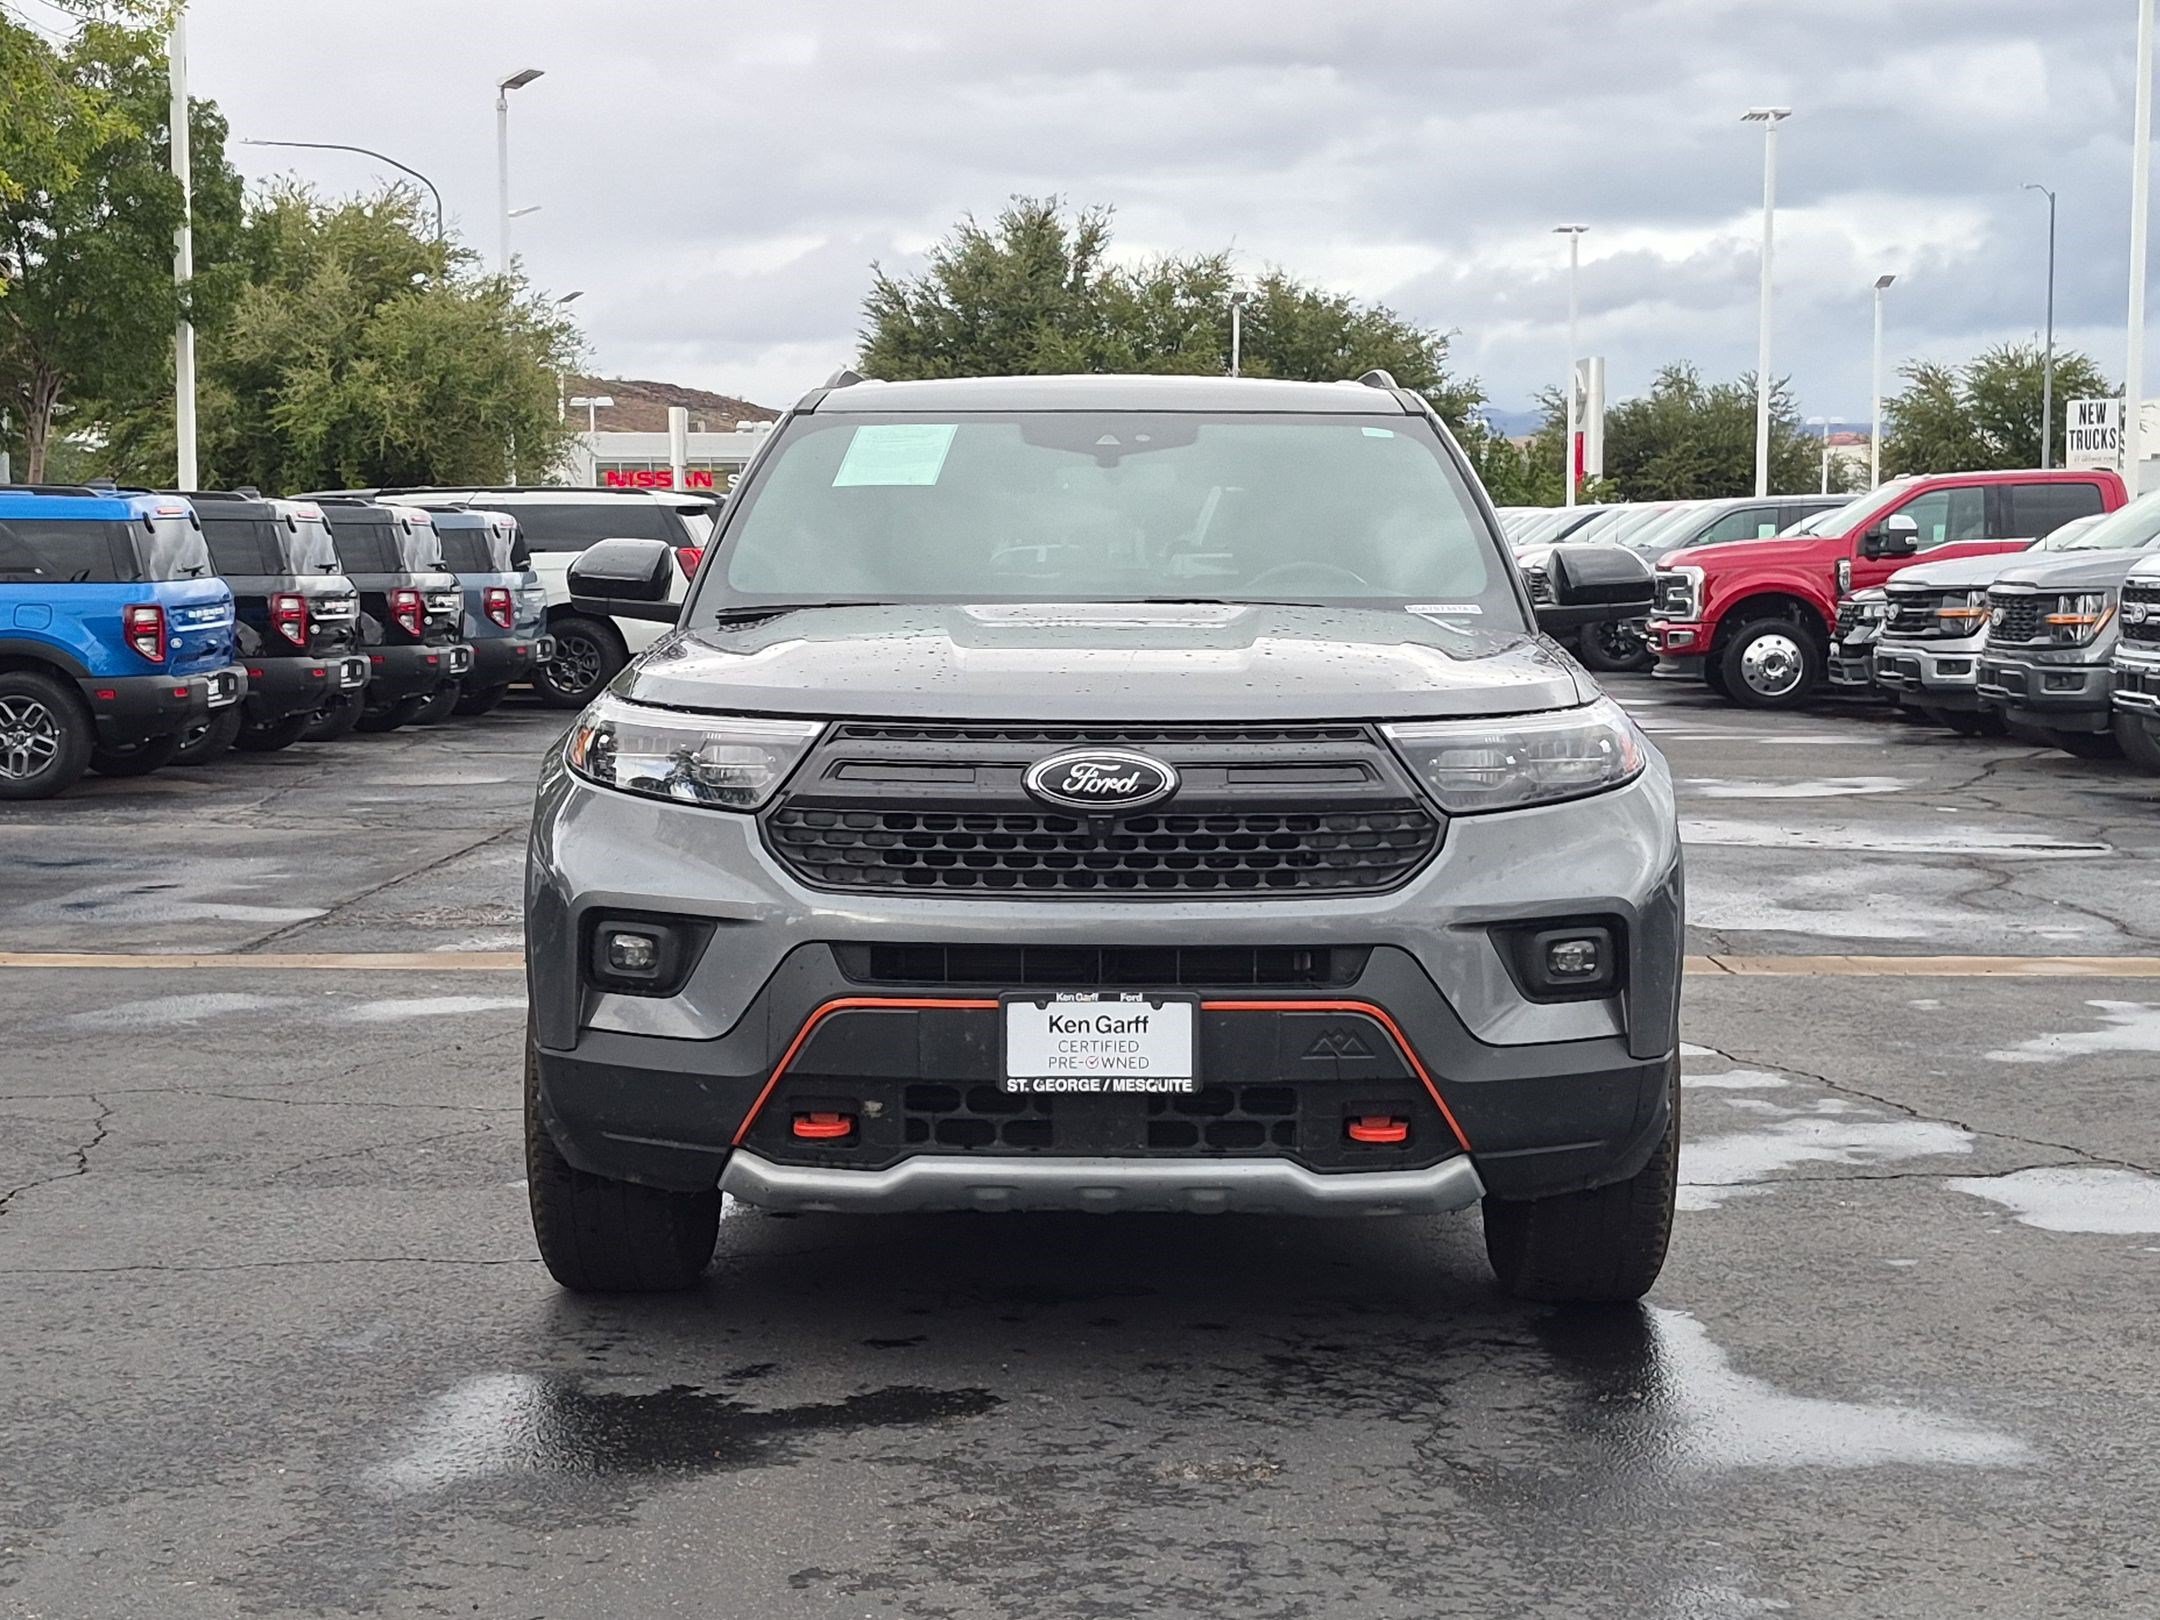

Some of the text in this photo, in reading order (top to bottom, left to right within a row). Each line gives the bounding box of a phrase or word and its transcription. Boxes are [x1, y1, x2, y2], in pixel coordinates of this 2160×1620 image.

[2079, 402, 2106, 425] NEW
[2068, 427, 2117, 451] TRUCKS
[606, 470, 713, 487] NISSN
[1062, 762, 1140, 794] Ford
[1056, 992, 1074, 1002] Ken
[1120, 992, 1143, 1002] Ford
[1049, 1015, 1149, 1034] Ken Garff
[1058, 1040, 1139, 1053] CERTIFIED
[1007, 1079, 1029, 1092] ST.
[1033, 1079, 1100, 1092] GEORGE
[1113, 1079, 1193, 1092] MESQUITE
